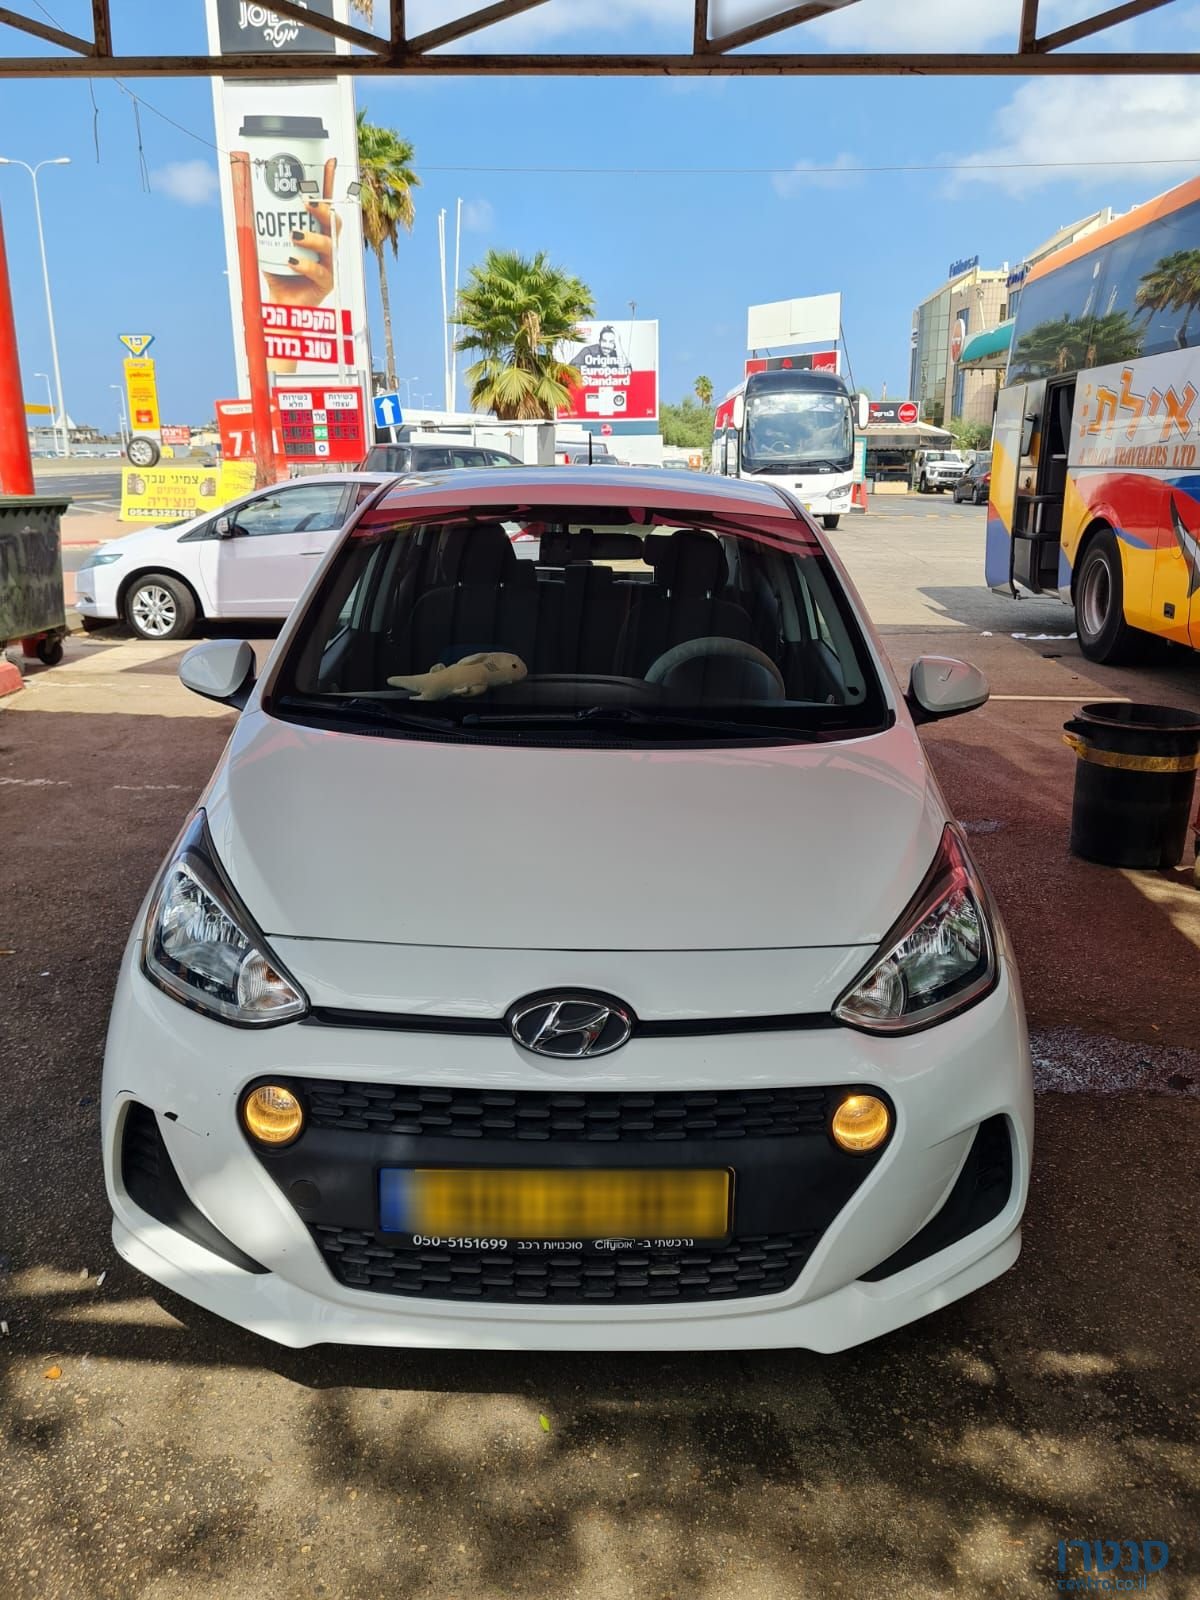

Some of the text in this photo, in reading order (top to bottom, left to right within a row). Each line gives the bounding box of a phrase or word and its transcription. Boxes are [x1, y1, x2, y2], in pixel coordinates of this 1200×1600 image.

[274, 173, 298, 193] JOE
[262, 306, 335, 331] הקפה הכי
[305, 339, 331, 359] טוב
[580, 365, 632, 377] European
[582, 376, 631, 386] Standard
[1172, 444, 1197, 465] LTD
[412, 1234, 508, 1250] 050-5151699
[517, 1241, 540, 1250] רכב
[543, 1240, 583, 1250] סוכנויות
[654, 1238, 694, 1248] נרכשתי
